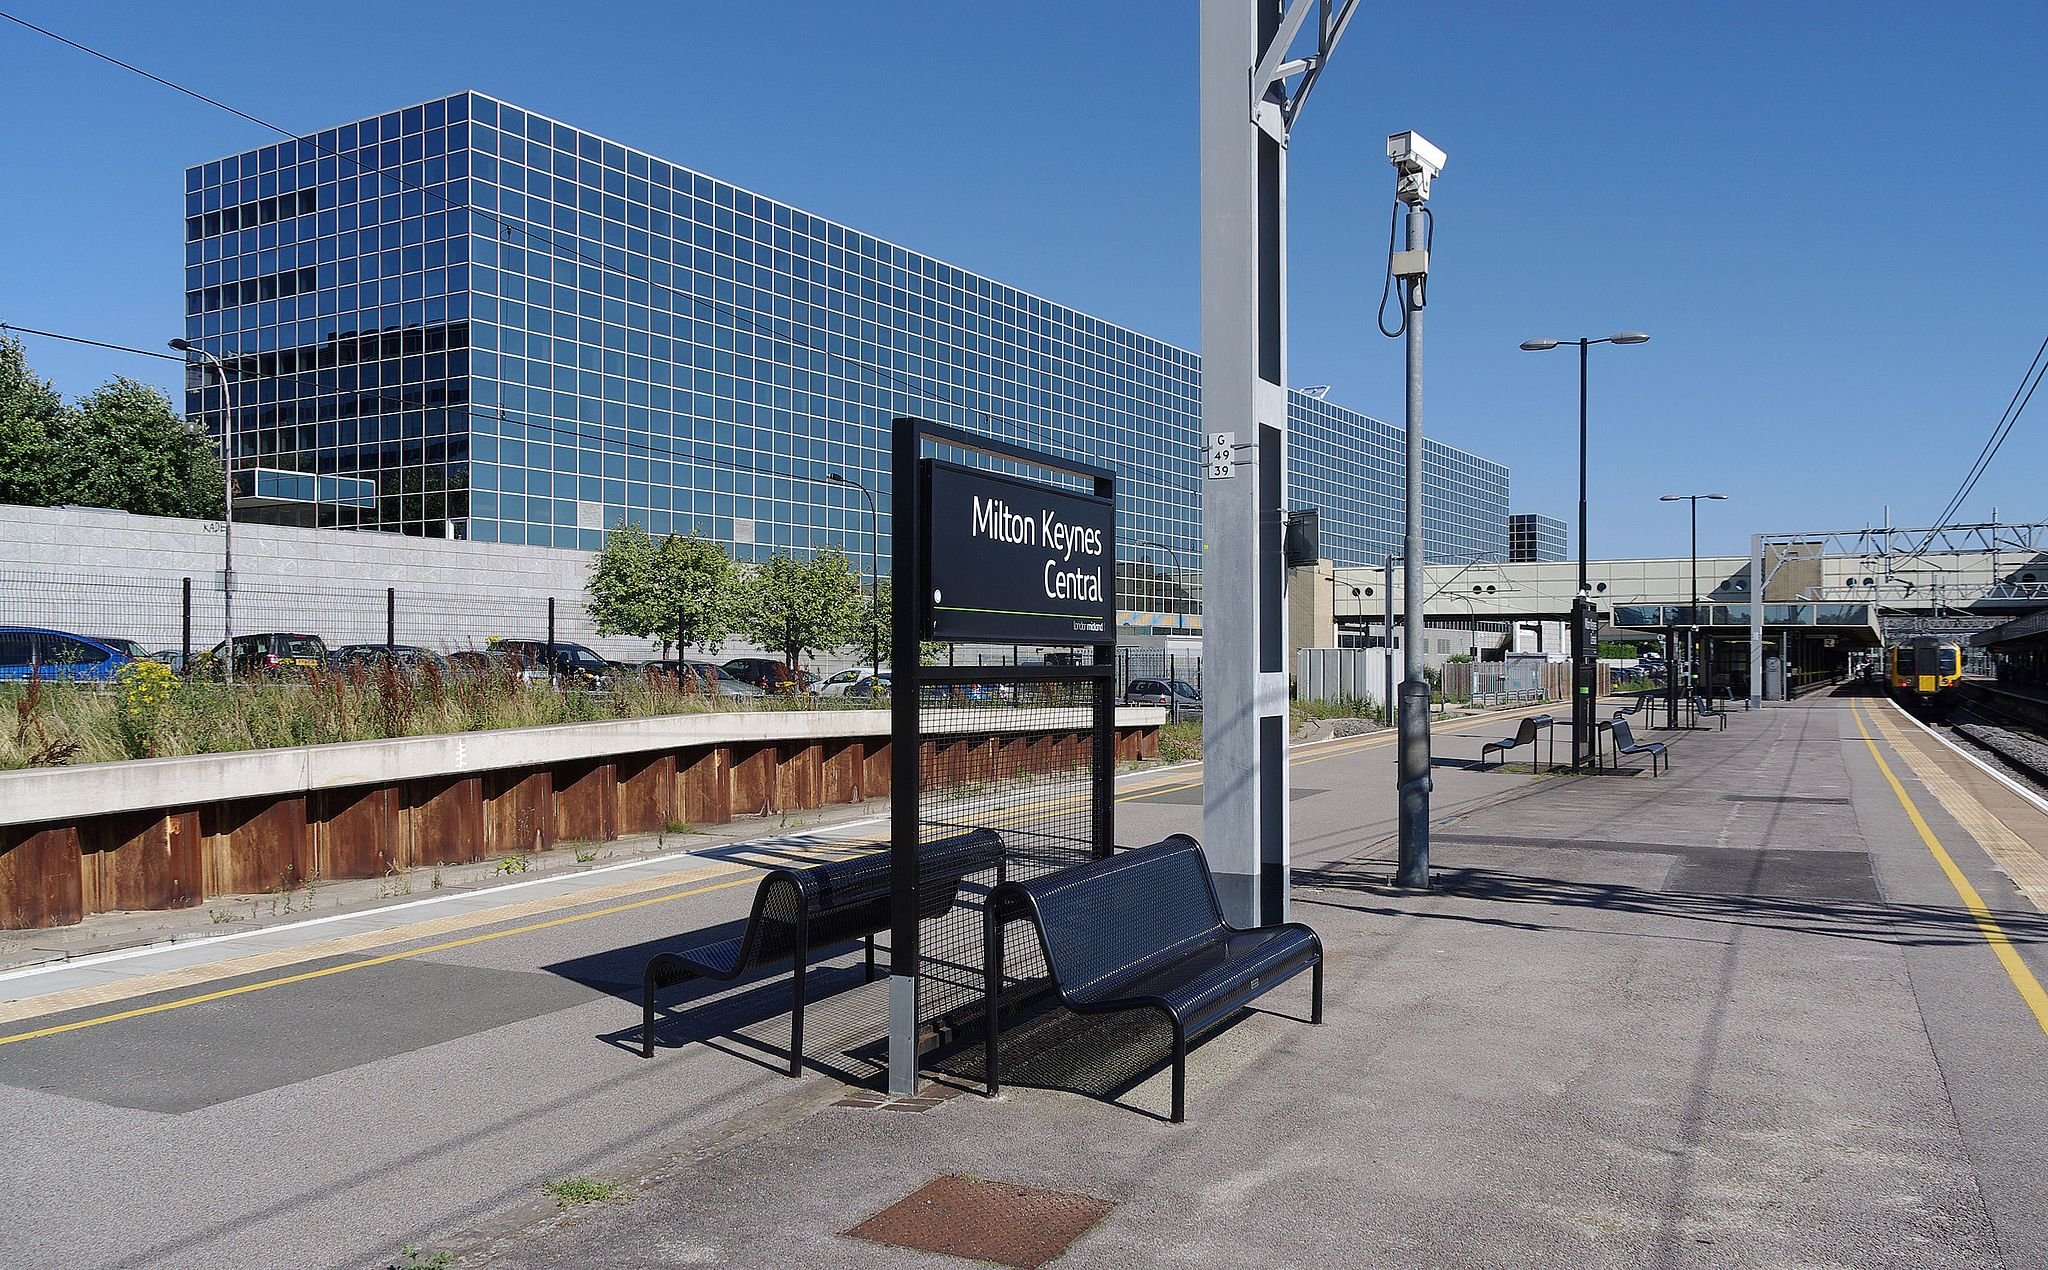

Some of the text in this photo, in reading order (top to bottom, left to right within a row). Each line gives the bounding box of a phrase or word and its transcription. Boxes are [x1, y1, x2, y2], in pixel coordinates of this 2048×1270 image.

[1217, 435, 1225, 445] G
[1214, 450, 1229, 460] 49
[1214, 466, 1229, 476] 39
[972, 495, 1102, 562] Milton Keynes
[1044, 560, 1104, 603] Central
